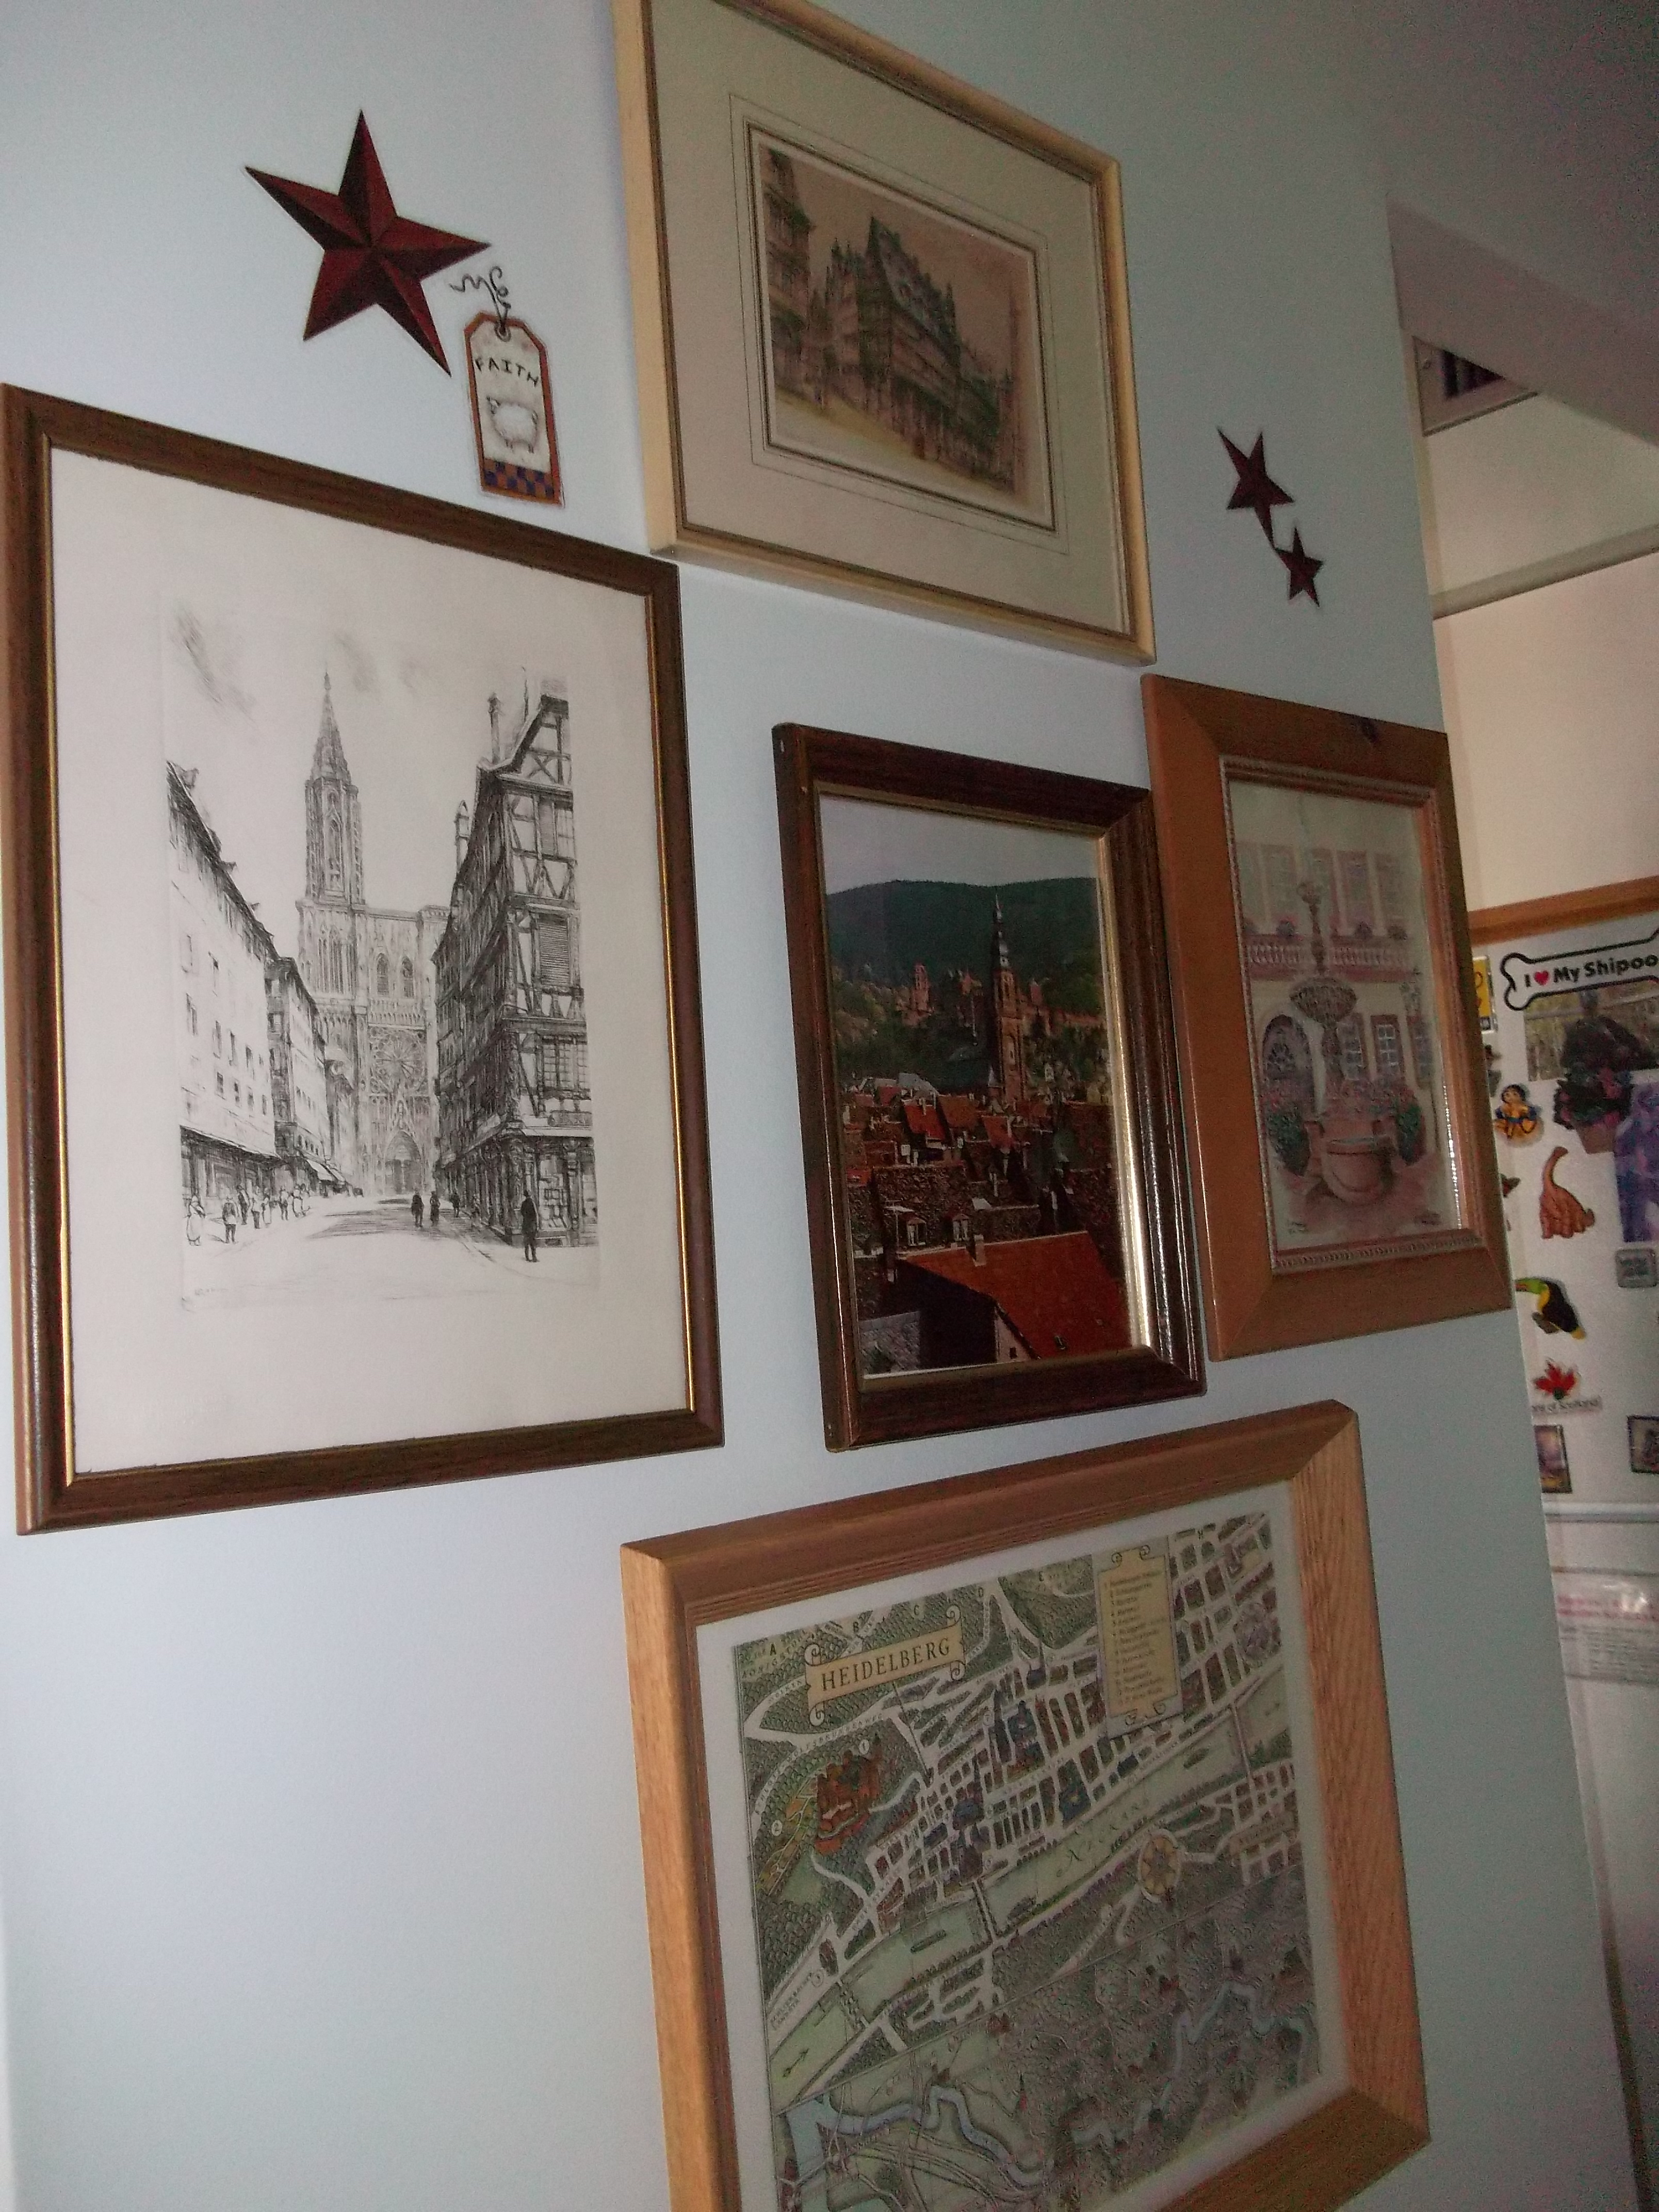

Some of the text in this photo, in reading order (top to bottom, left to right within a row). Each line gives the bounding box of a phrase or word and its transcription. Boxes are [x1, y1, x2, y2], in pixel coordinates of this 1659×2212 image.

[475, 357, 539, 387] FAITH
[1523, 954, 1658, 988] I My Shipoo
[769, 1643, 777, 1656] A
[822, 1637, 951, 1691] HEIDELBERG
